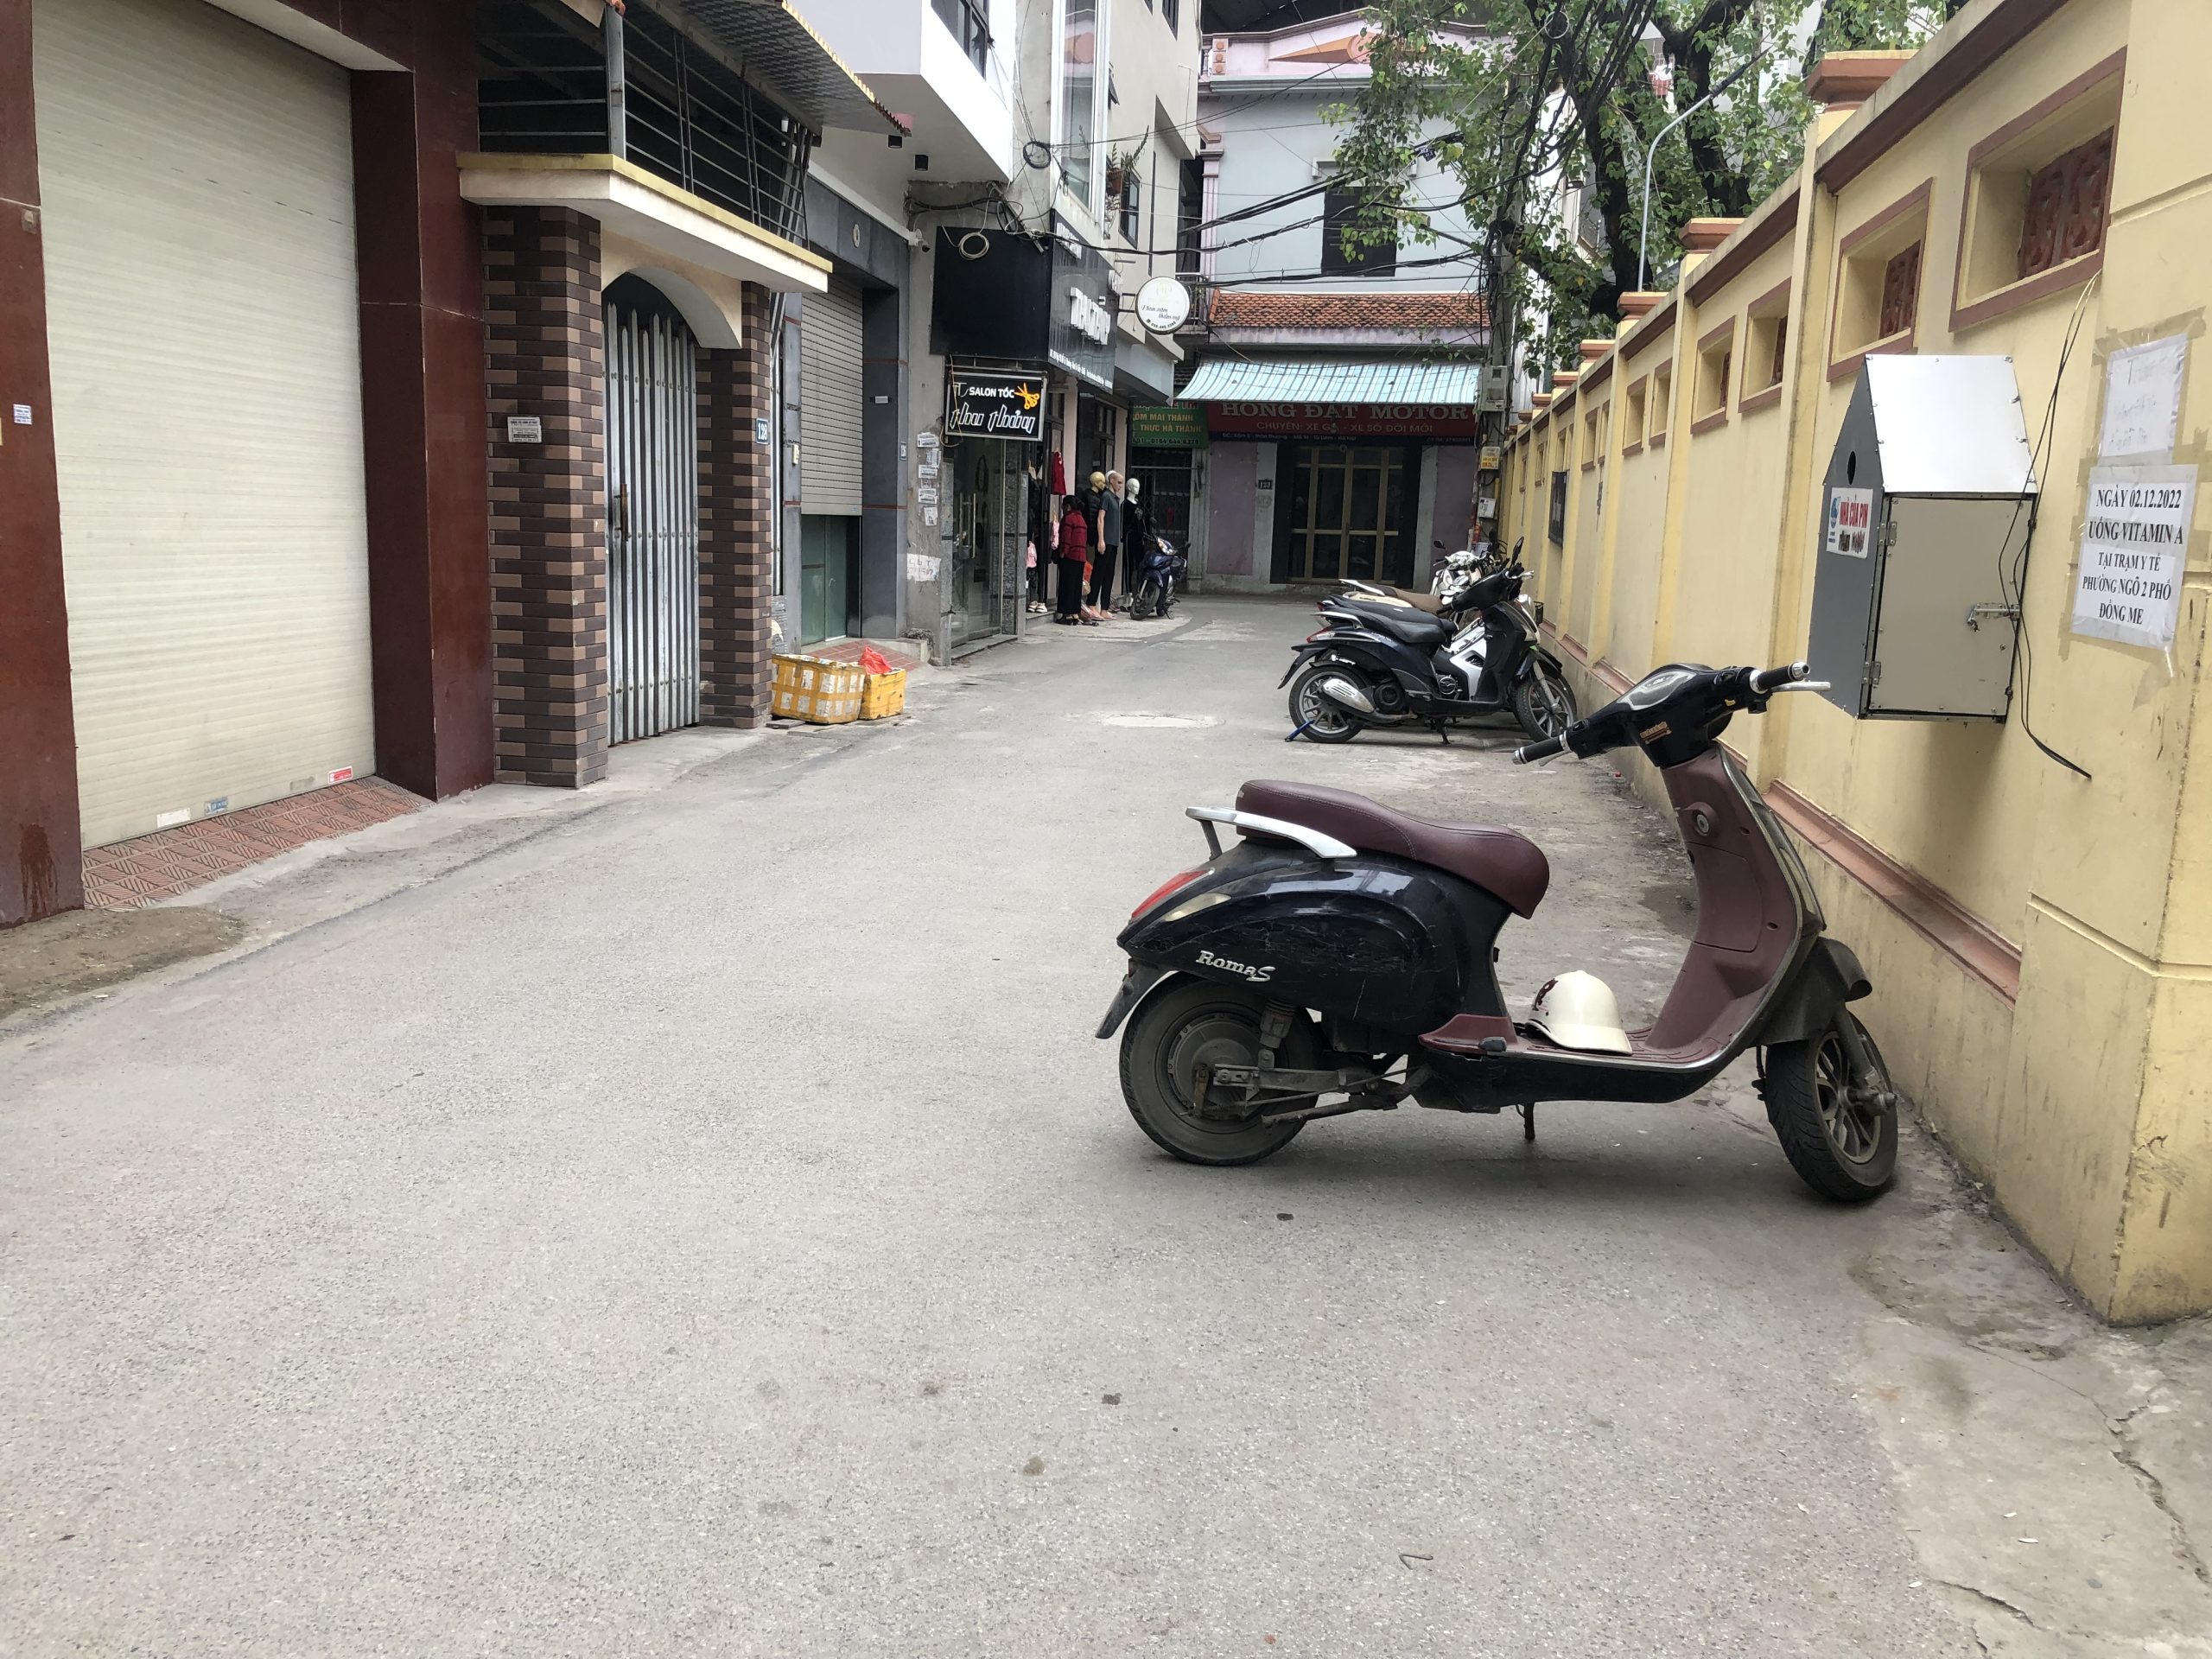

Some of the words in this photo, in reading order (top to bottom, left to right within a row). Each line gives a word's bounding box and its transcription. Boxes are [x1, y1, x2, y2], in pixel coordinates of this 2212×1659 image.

[969, 386, 996, 397] SALON
[997, 386, 1015, 398] TÓC
[1370, 404, 1469, 420] MOTOR
[2096, 484, 2128, 508] NGÀY
[2129, 489, 2183, 509] 02.12.2022
[2088, 517, 2119, 540] UỐNG
[2121, 521, 2174, 544] VITAMIN
[2174, 525, 2183, 545] A
[2098, 551, 2113, 570] TẠI
[2113, 553, 2139, 572] TRẠM
[2140, 555, 2148, 570] Y
[2148, 552, 2161, 572] TẾ
[2082, 573, 2118, 594] PHƯỜNG
[2117, 575, 2140, 596] NGÕ
[2140, 581, 2148, 597] 2
[2148, 578, 2172, 601] PHỐ
[2098, 599, 2126, 622] ĐỒNG
[2126, 607, 2144, 625] ME
